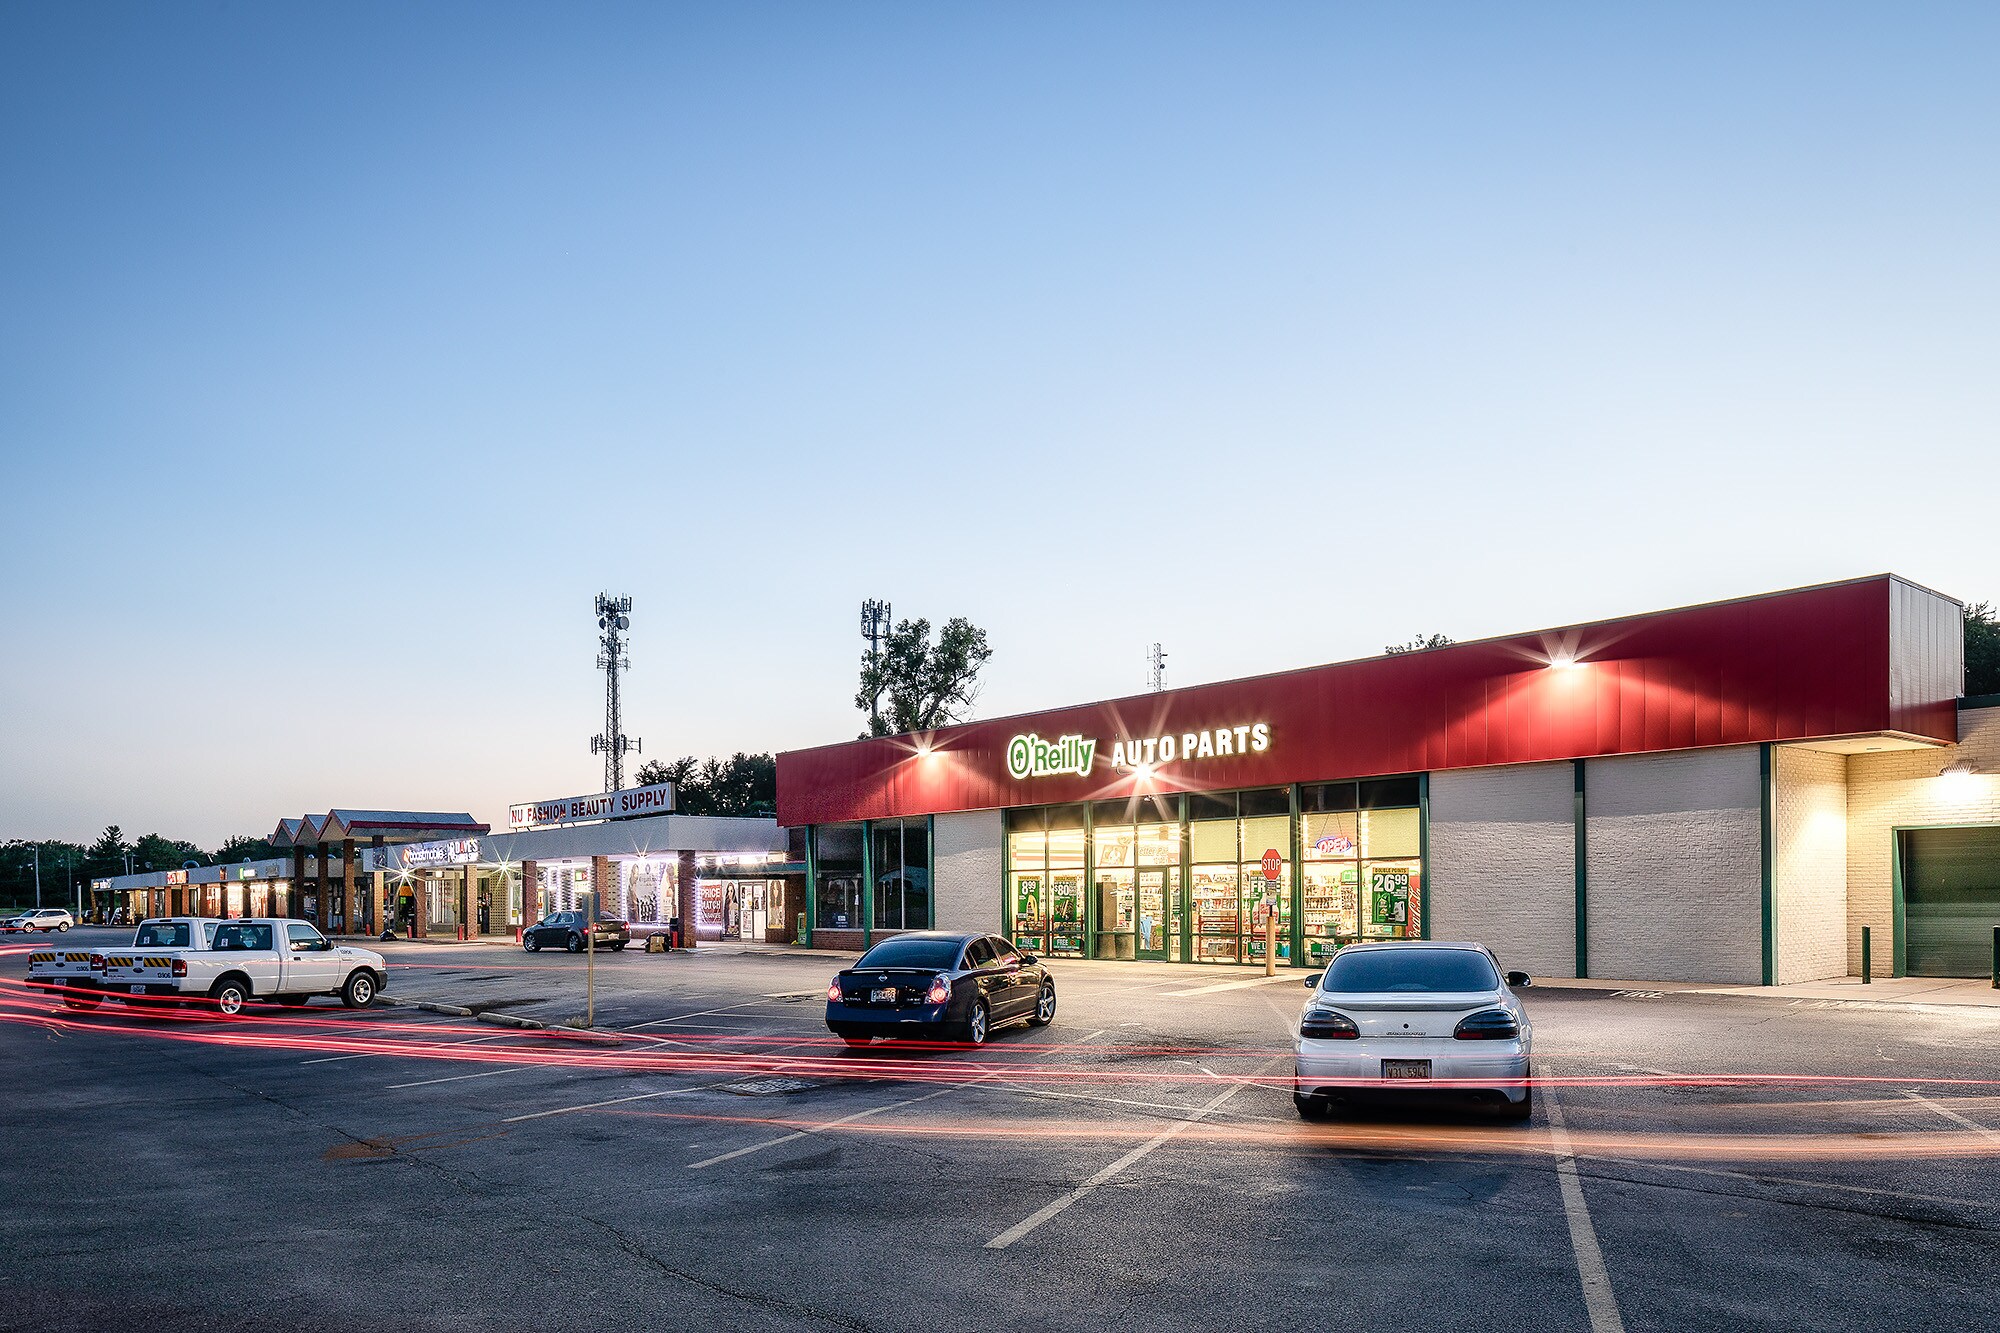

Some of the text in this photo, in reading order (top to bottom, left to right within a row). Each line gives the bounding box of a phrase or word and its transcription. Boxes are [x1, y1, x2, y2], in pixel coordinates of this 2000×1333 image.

[1009, 723, 1269, 777] O'Reilly AUTO PARTS
[511, 788, 667, 823] NU FASHION BEAUTY SUPPLY
[1319, 837, 1349, 853] OPEN
[1262, 858, 1280, 871] STOP
[1250, 880, 1281, 893] FRE
[1056, 938, 1068, 946] FREE
